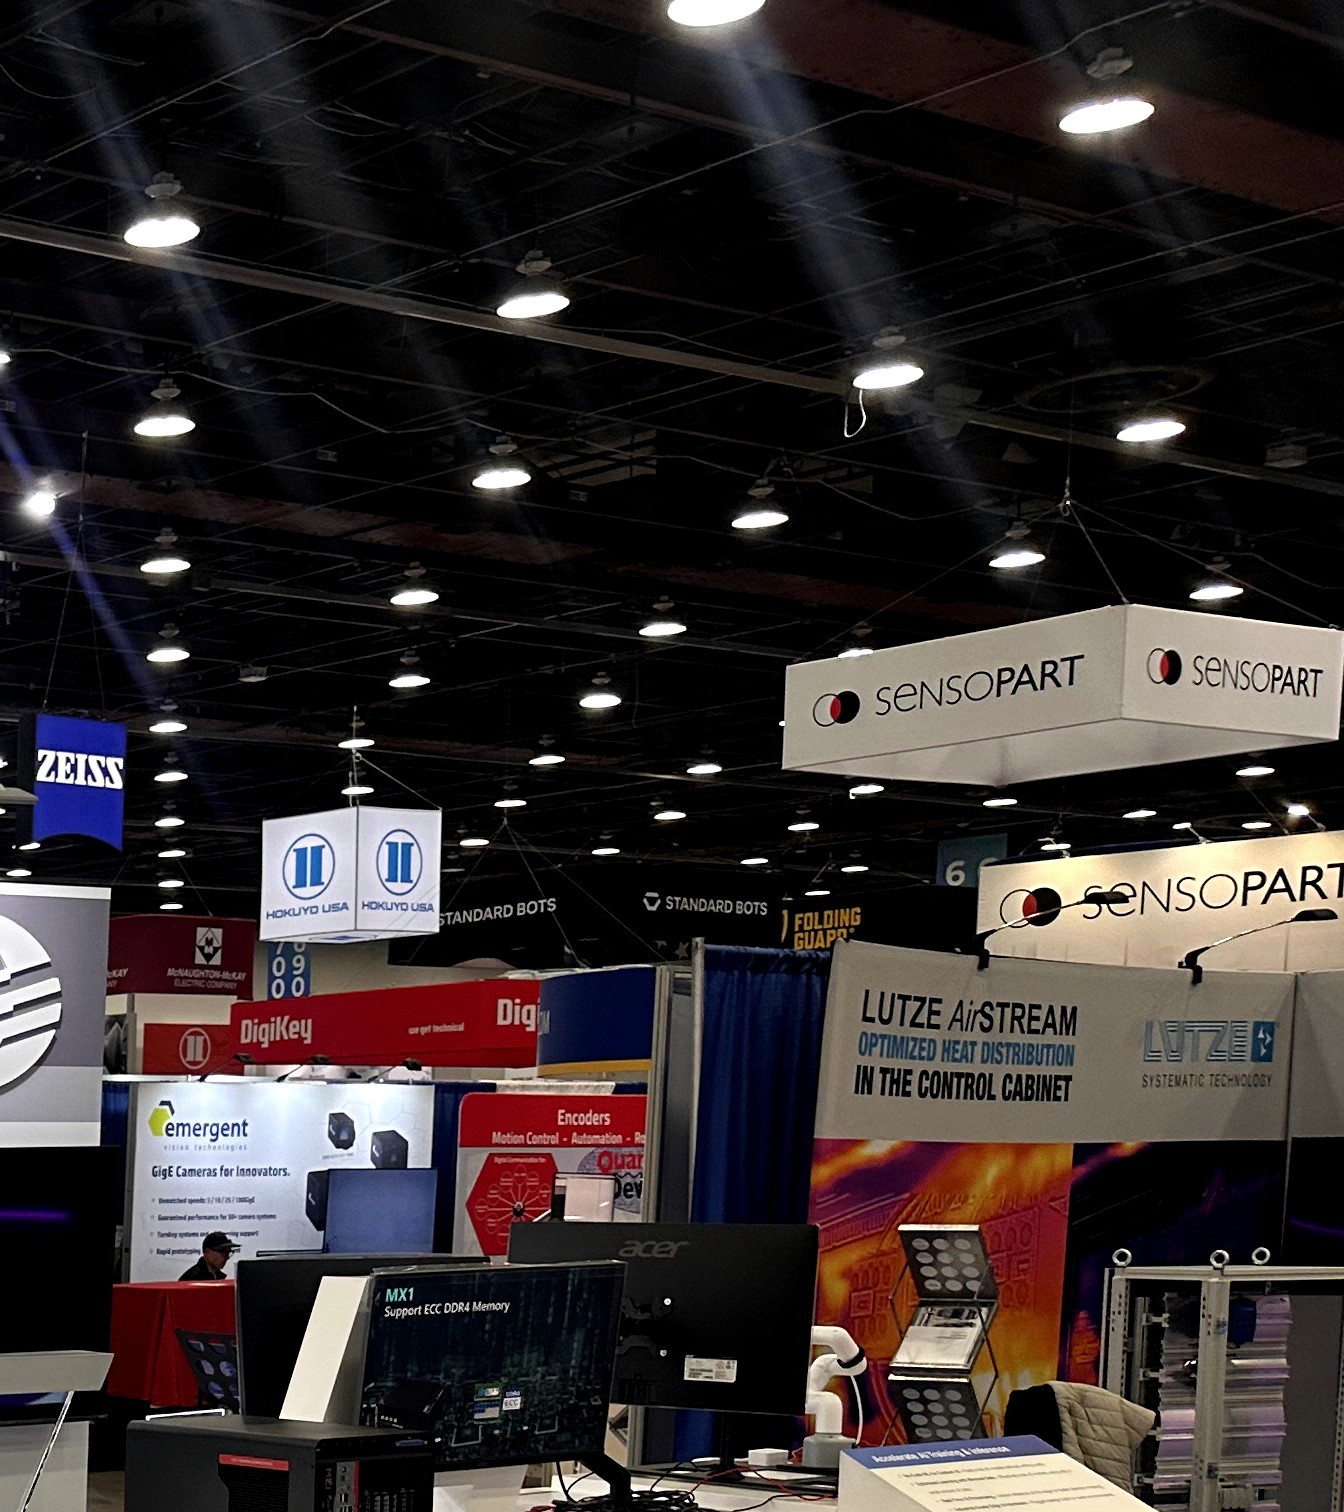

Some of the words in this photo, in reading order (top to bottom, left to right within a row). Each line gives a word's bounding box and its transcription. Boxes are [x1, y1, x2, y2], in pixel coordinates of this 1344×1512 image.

[37, 749, 124, 790] ZEISS
[266, 905, 320, 920] HOKUYO
[322, 902, 349, 914] USA
[362, 901, 409, 912] HOKUYO
[411, 902, 435, 912] USA
[439, 904, 514, 926] STANDARD
[517, 897, 557, 916] BOTS
[665, 896, 733, 914] STANDARD
[735, 900, 768, 916] BOTS
[794, 907, 861, 932] FOLDING
[861, 989, 943, 1030] LUTZE
[947, 1000, 1078, 1036] AirSTREAM
[241, 1015, 312, 1048] DigiKey
[858, 1031, 937, 1062] OPTIMIZED
[940, 1038, 978, 1065] HEAT
[980, 1041, 1075, 1066] DISTRIBUTION
[854, 1064, 875, 1095] IN
[879, 1066, 913, 1098] THE
[917, 1069, 996, 1101] CONTROL
[1002, 1073, 1072, 1102] CABINET
[1142, 1073, 1205, 1089] SYSTEMATIC
[1209, 1073, 1273, 1088] TECHNOLOGY
[557, 1109, 611, 1126] Encoders
[165, 1118, 249, 1142] emergent
[492, 1131, 524, 1145] Motion
[526, 1131, 559, 1145] Control
[571, 1131, 623, 1145] Automation
[152, 1165, 174, 1180] GigE
[176, 1165, 218, 1178] Cameras
[220, 1164, 235, 1178] for
[619, 1239, 690, 1259] acer
[385, 1287, 415, 1303] MX1
[384, 1304, 423, 1320] Support
[423, 1302, 442, 1315] ECC
[444, 1301, 470, 1315] DDR4
[472, 1299, 511, 1315] Memory
